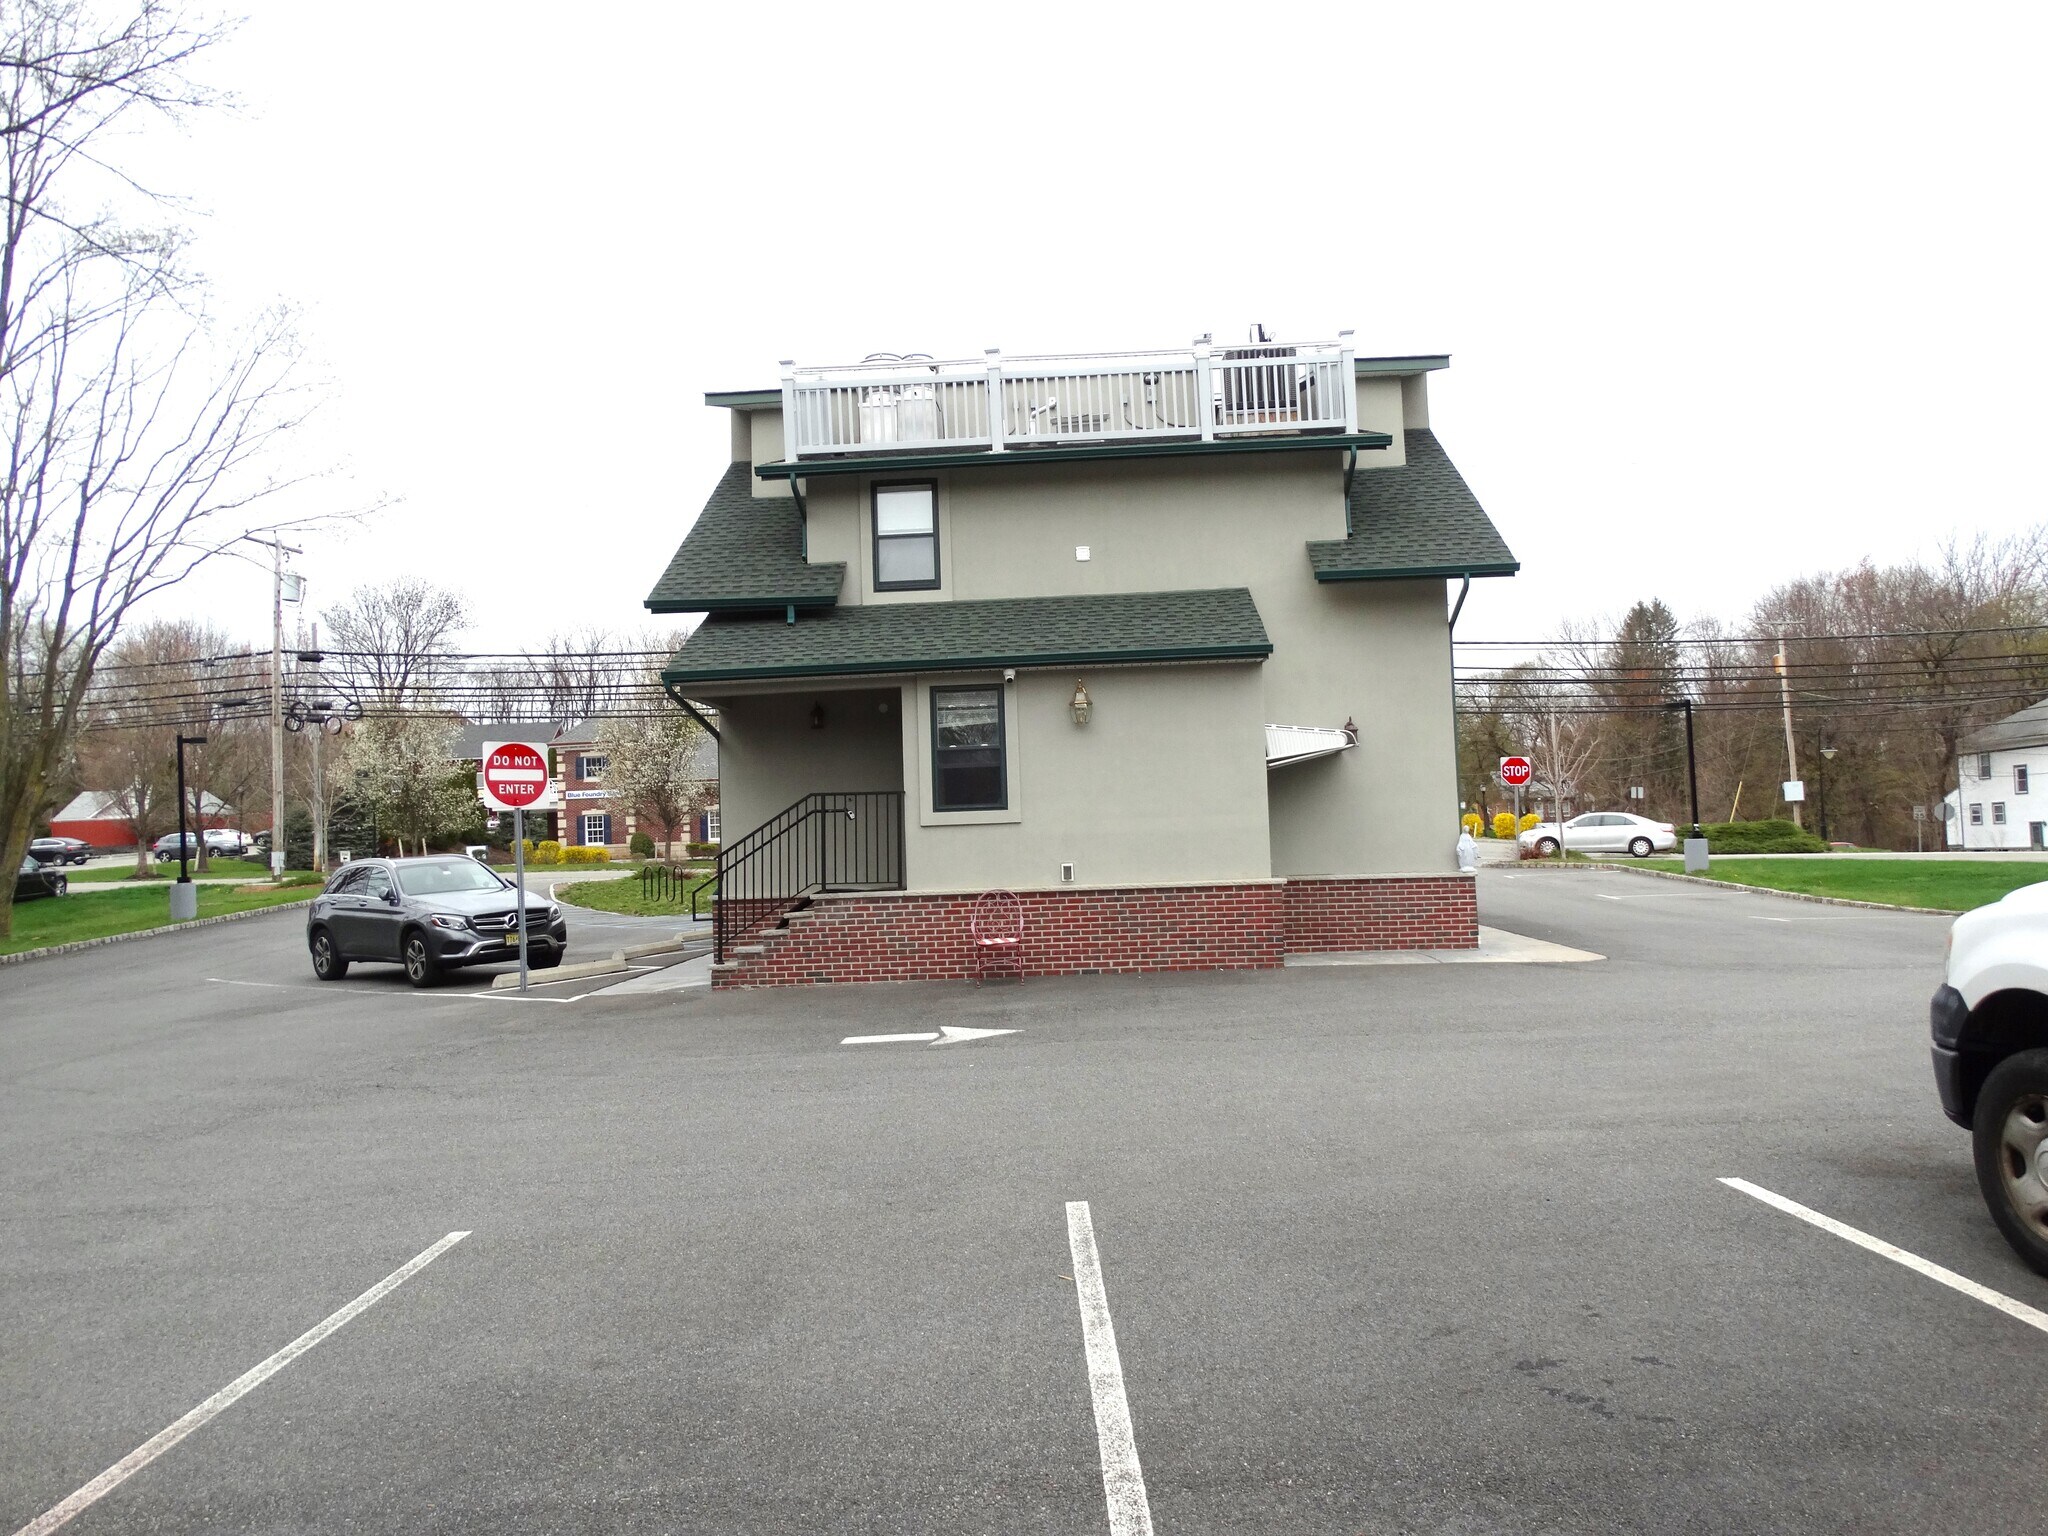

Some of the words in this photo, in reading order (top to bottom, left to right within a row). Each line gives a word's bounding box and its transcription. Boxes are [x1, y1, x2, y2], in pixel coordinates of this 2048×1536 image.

[493, 755, 510, 766] DO
[514, 756, 538, 766] NOT
[1503, 765, 1529, 777] STOP
[498, 784, 535, 794] ENTER
